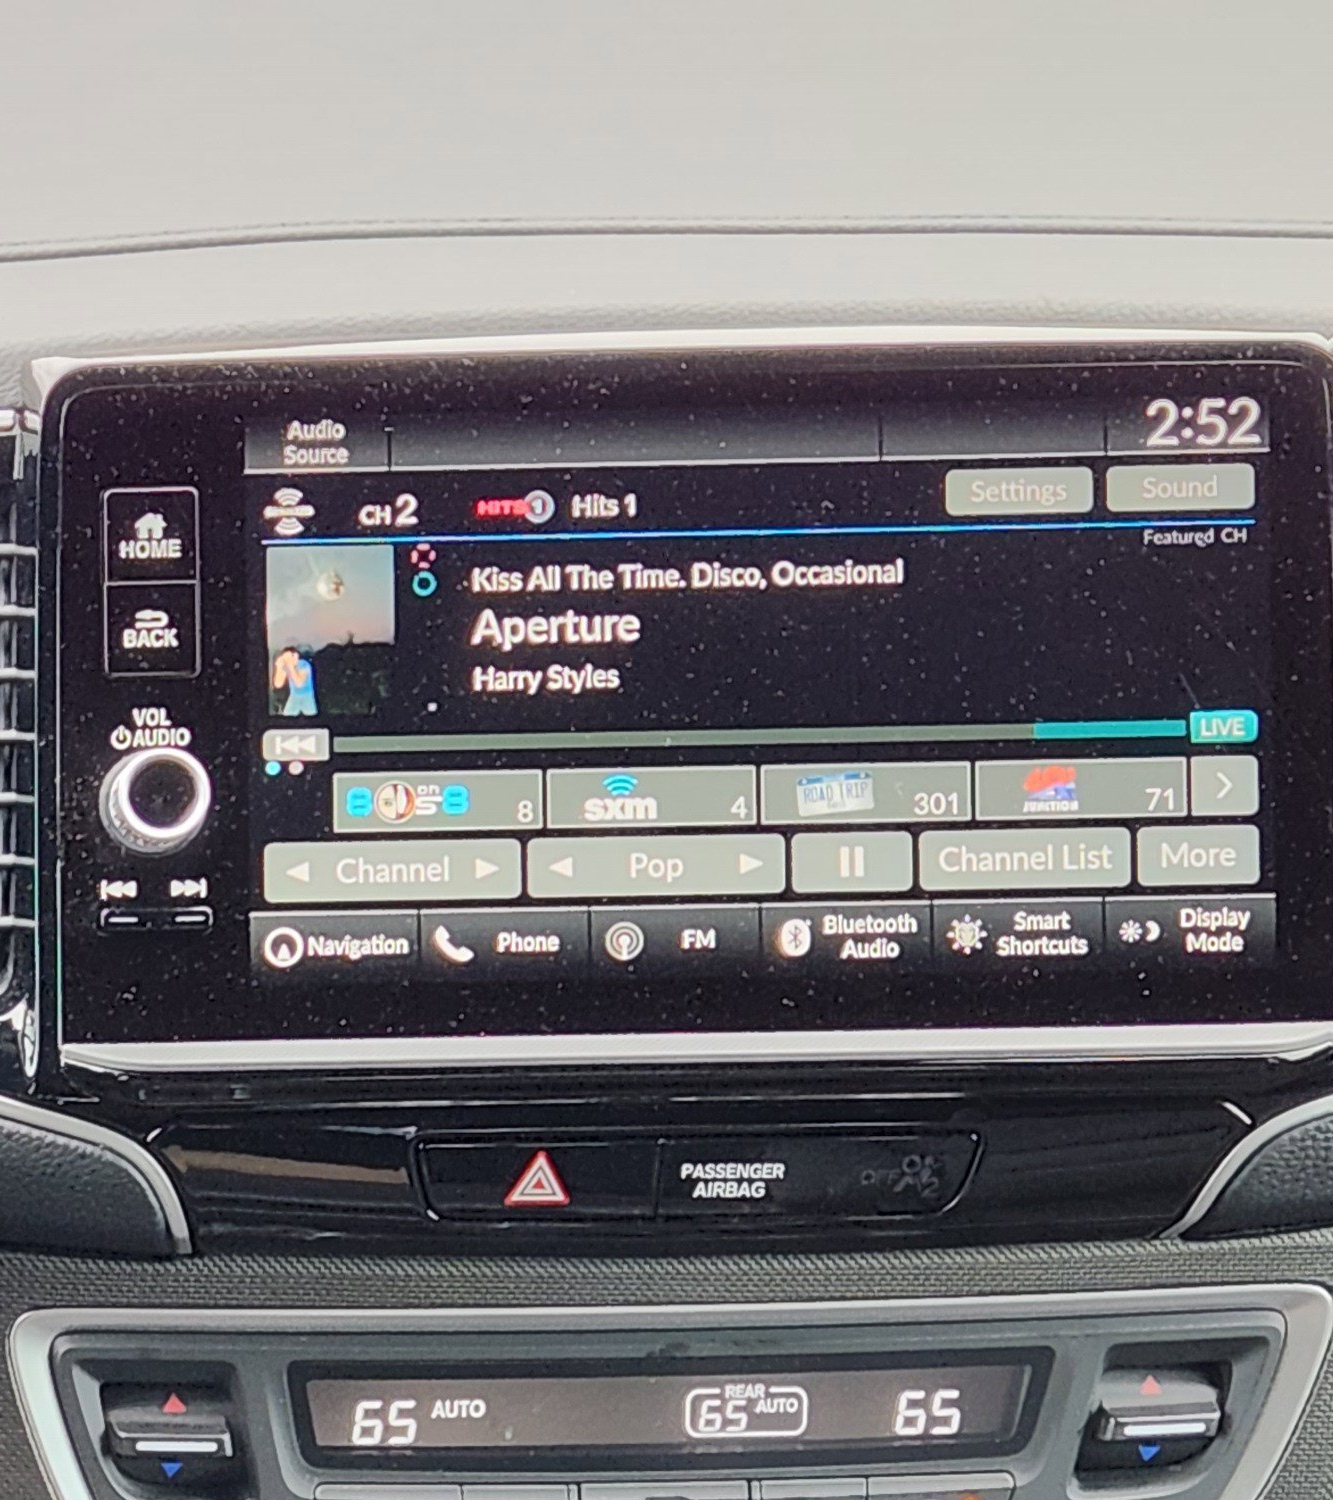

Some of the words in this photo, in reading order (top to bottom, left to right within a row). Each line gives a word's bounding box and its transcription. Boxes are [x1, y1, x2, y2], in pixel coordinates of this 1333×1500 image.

[287, 419, 347, 441] Audio
[1145, 396, 1262, 449] 2:52
[282, 443, 350, 466] Source
[970, 478, 1068, 506] Settings
[1142, 475, 1219, 500] Sound
[571, 493, 620, 519] Hits
[624, 492, 638, 519] 1
[118, 538, 182, 561] HOME
[1143, 527, 1215, 549] Featured
[1221, 527, 1248, 545] CH
[470, 566, 523, 592] Kiss
[526, 564, 561, 592] All
[565, 564, 614, 591] The
[617, 562, 687, 590] Time.
[691, 560, 768, 591] Disco,
[771, 557, 905, 588] Occasional
[122, 626, 179, 650] BACK
[470, 608, 642, 651] Aperture
[472, 665, 543, 695] Harry
[546, 663, 621, 694] Styles
[132, 708, 172, 729] VOL
[1200, 717, 1245, 737] LIVE
[132, 724, 192, 748] AUDIO
[517, 800, 534, 824] 8
[584, 796, 658, 822] sxm
[730, 795, 749, 819] 4
[913, 792, 960, 816] 301
[1145, 788, 1176, 812] 71
[938, 846, 1057, 872] Channel
[1063, 844, 1114, 870] List
[1160, 843, 1237, 868] More
[336, 856, 451, 884] Channel
[629, 852, 685, 884] Pop
[822, 913, 918, 935] Bluetooth
[1013, 910, 1071, 932] Smart
[1179, 907, 1251, 933] Display
[307, 932, 410, 959] Navigation
[496, 931, 561, 953] Phone
[680, 929, 716, 950] FM
[840, 936, 901, 960] Audio
[996, 934, 1089, 957] Shortcuts
[1186, 931, 1244, 953] Mode
[680, 1162, 785, 1181] PASSENGER
[693, 1181, 766, 1199] AIRBAG
[725, 1383, 765, 1400] REAR
[351, 1399, 418, 1446] 65
[431, 1399, 487, 1419] AUTO
[698, 1399, 749, 1433] 65
[755, 1397, 799, 1415] AUTO
[893, 1389, 962, 1436] 65
